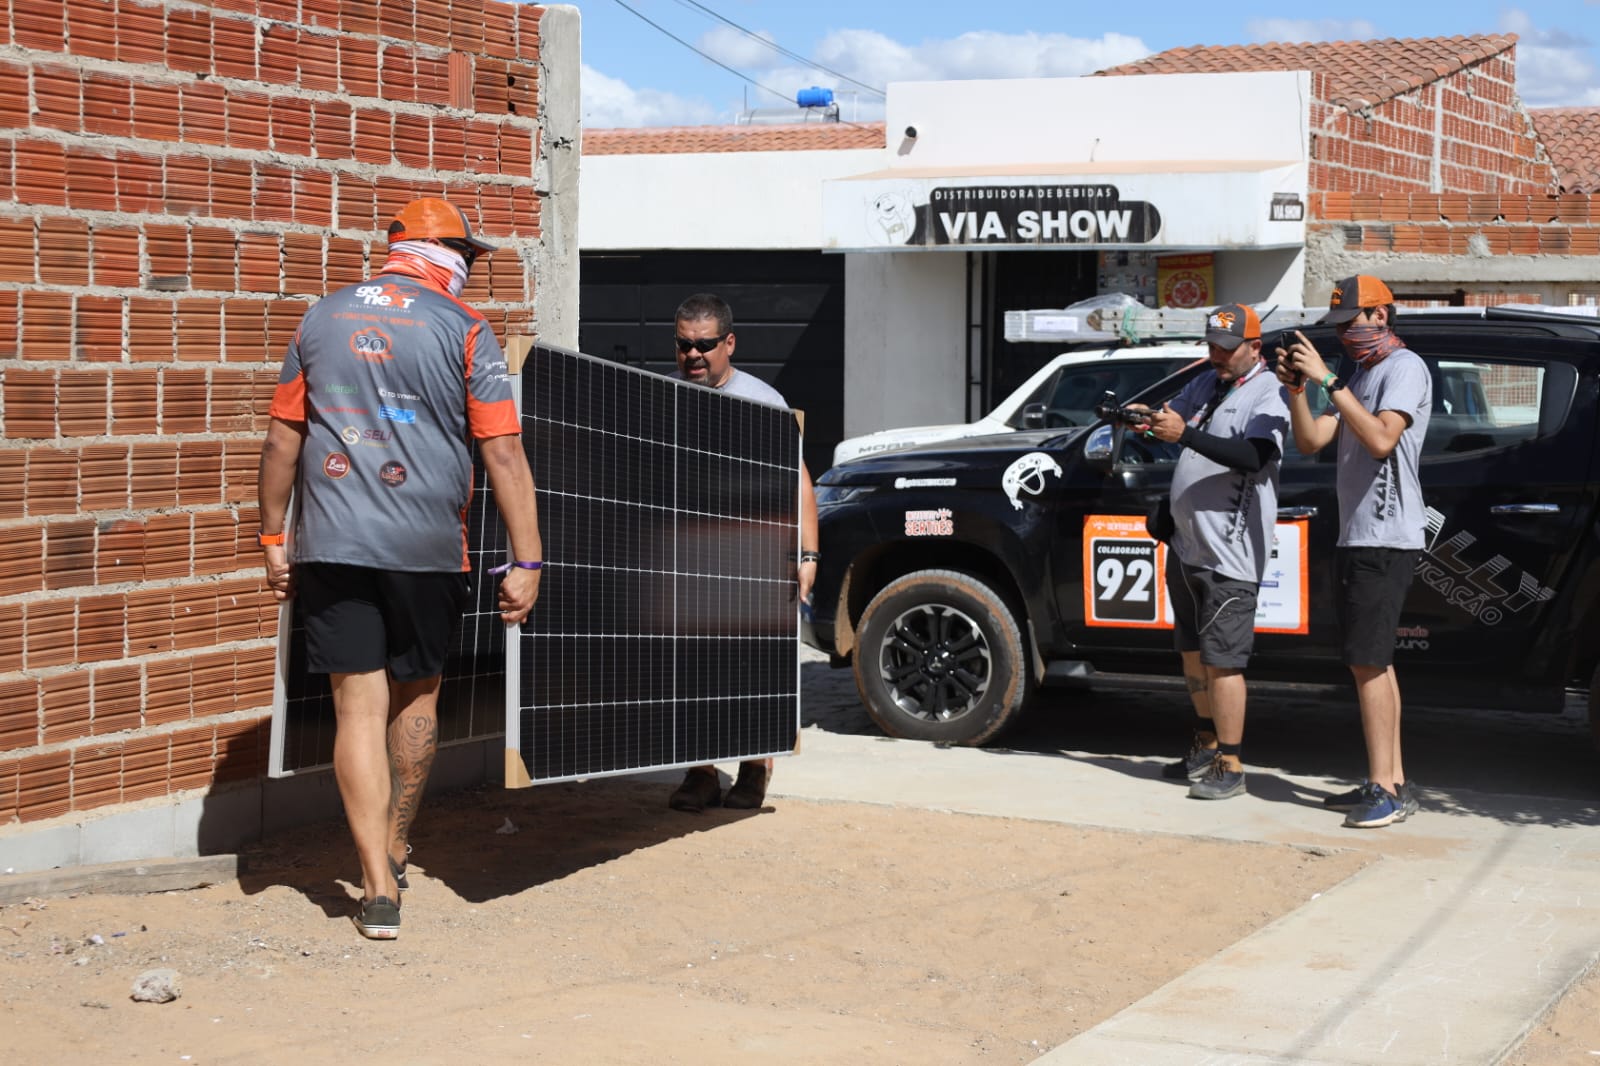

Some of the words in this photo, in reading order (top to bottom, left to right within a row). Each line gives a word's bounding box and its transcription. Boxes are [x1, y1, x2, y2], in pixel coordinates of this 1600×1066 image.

[934, 188, 1034, 200] DISTRIBUIDORA
[1037, 187, 1053, 198] DE
[1056, 187, 1112, 198] BEBIDAS
[939, 211, 1007, 240] VIA
[1016, 209, 1133, 239] SHOW
[1387, 503, 1396, 517] DA
[1097, 545, 1151, 555] COLABORADOR
[1097, 558, 1153, 602] 92
